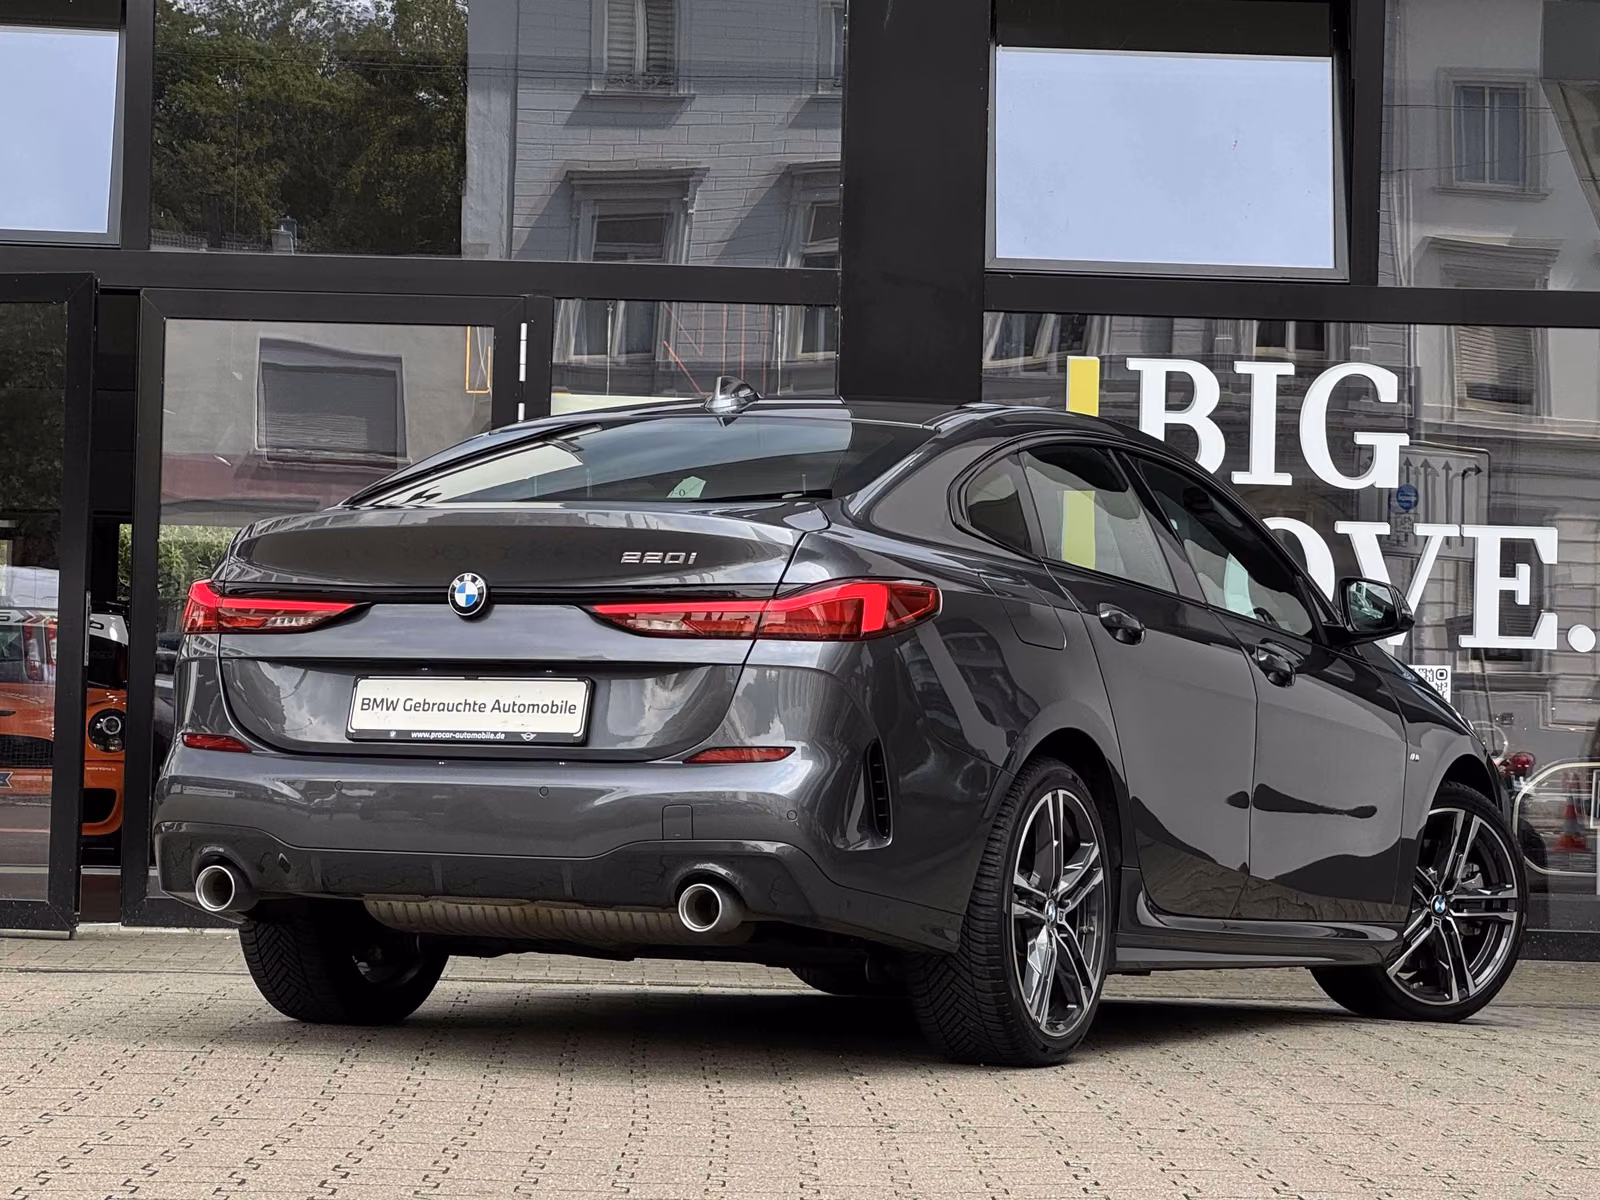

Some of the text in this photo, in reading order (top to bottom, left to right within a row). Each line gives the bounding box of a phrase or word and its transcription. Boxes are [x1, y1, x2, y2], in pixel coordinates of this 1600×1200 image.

[1125, 357, 1410, 489] BIG
[620, 551, 698, 565] 220i
[360, 697, 577, 715] BMW Gebrauchte Automobile
[411, 731, 506, 740] www.procar-automobile.de
